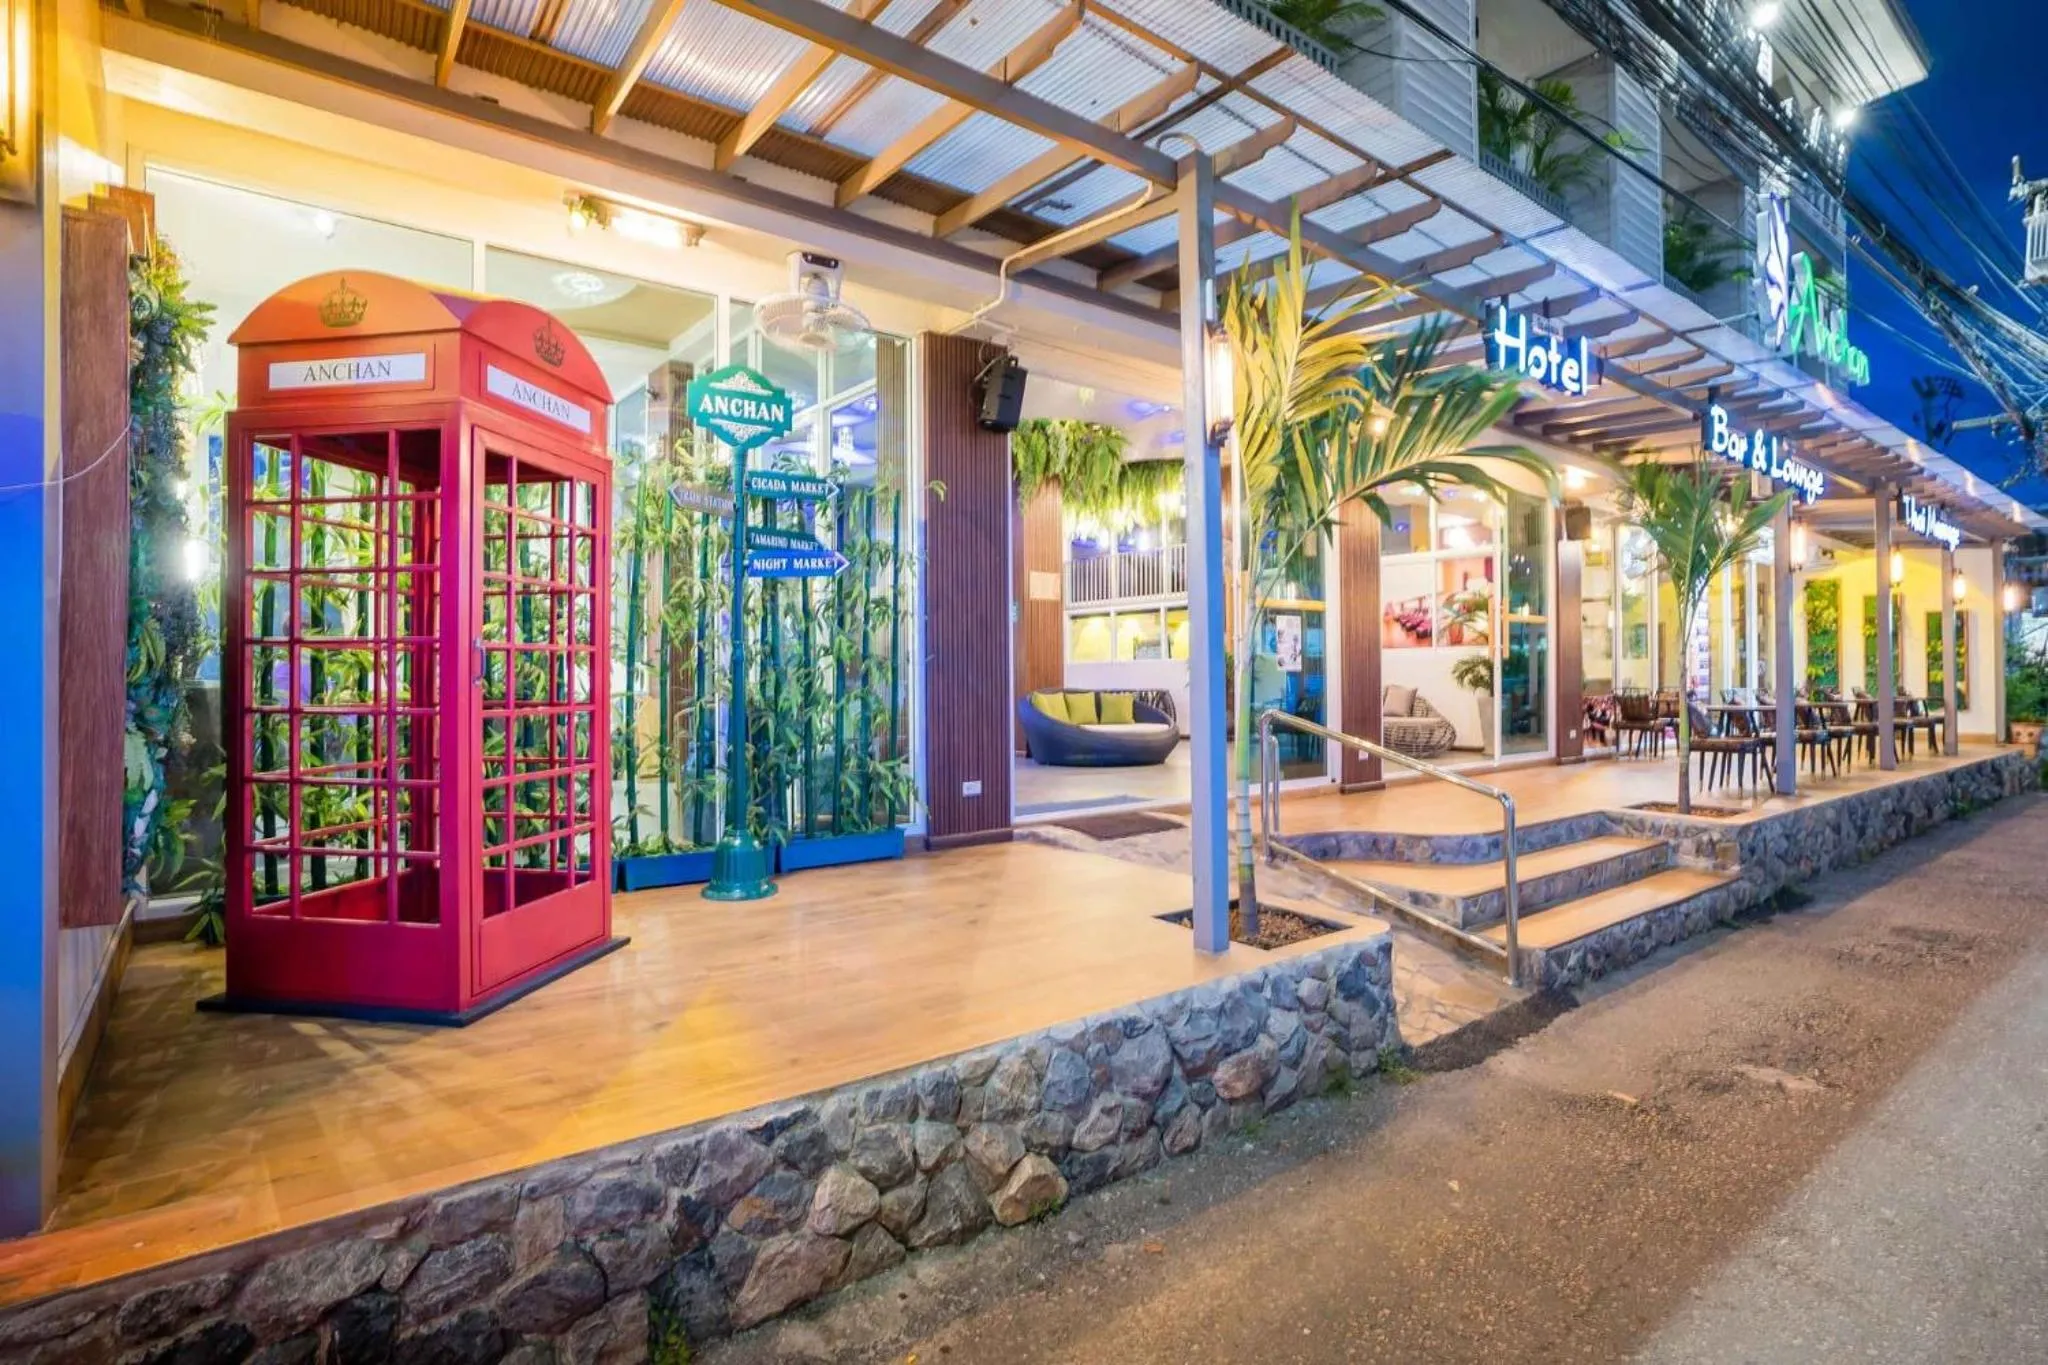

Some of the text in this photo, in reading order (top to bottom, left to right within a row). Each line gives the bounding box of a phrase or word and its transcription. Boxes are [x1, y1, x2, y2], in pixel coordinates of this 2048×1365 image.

[1789, 251, 1870, 386] Anchan
[1494, 304, 1588, 397] Hotel
[303, 360, 392, 383] ANCHAN
[511, 382, 571, 421] ANCHAN
[699, 393, 785, 423] ANCHAN
[1710, 403, 1825, 505] Bar & Lounge
[751, 477, 830, 495] CICADA MARKET
[750, 532, 820, 550] TAMARIND MARKET
[752, 557, 839, 571] NIGHT MARKET
